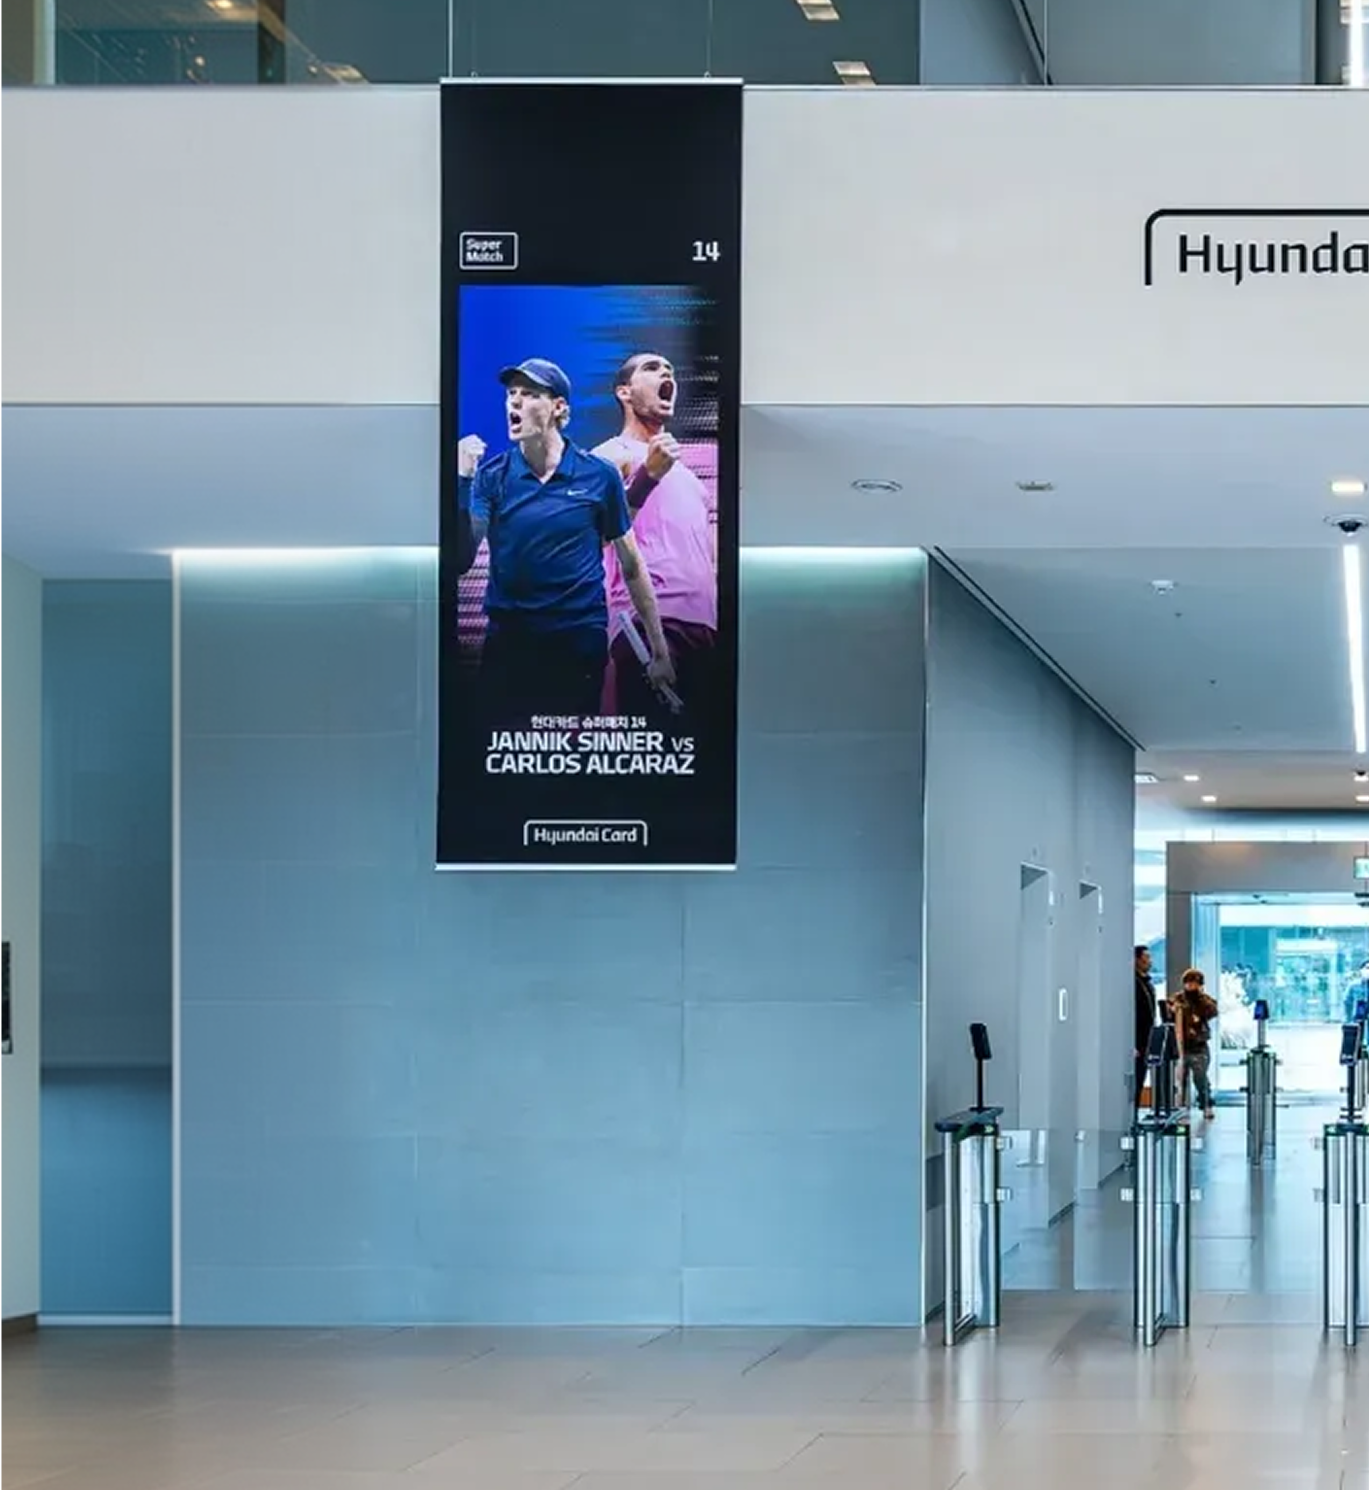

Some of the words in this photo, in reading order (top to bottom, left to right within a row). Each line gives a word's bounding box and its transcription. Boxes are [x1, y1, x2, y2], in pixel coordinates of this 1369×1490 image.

[466, 238, 503, 251] Super
[692, 241, 721, 261] 14
[466, 251, 504, 263] Match
[630, 715, 647, 730] 14
[487, 731, 573, 751] JANNIK
[577, 731, 664, 751] SINNER
[671, 736, 695, 751] VS
[485, 753, 582, 775] CARLOS
[585, 753, 695, 775] ALCARAZ
[534, 826, 600, 846] Hyundai
[601, 828, 637, 843] Card
